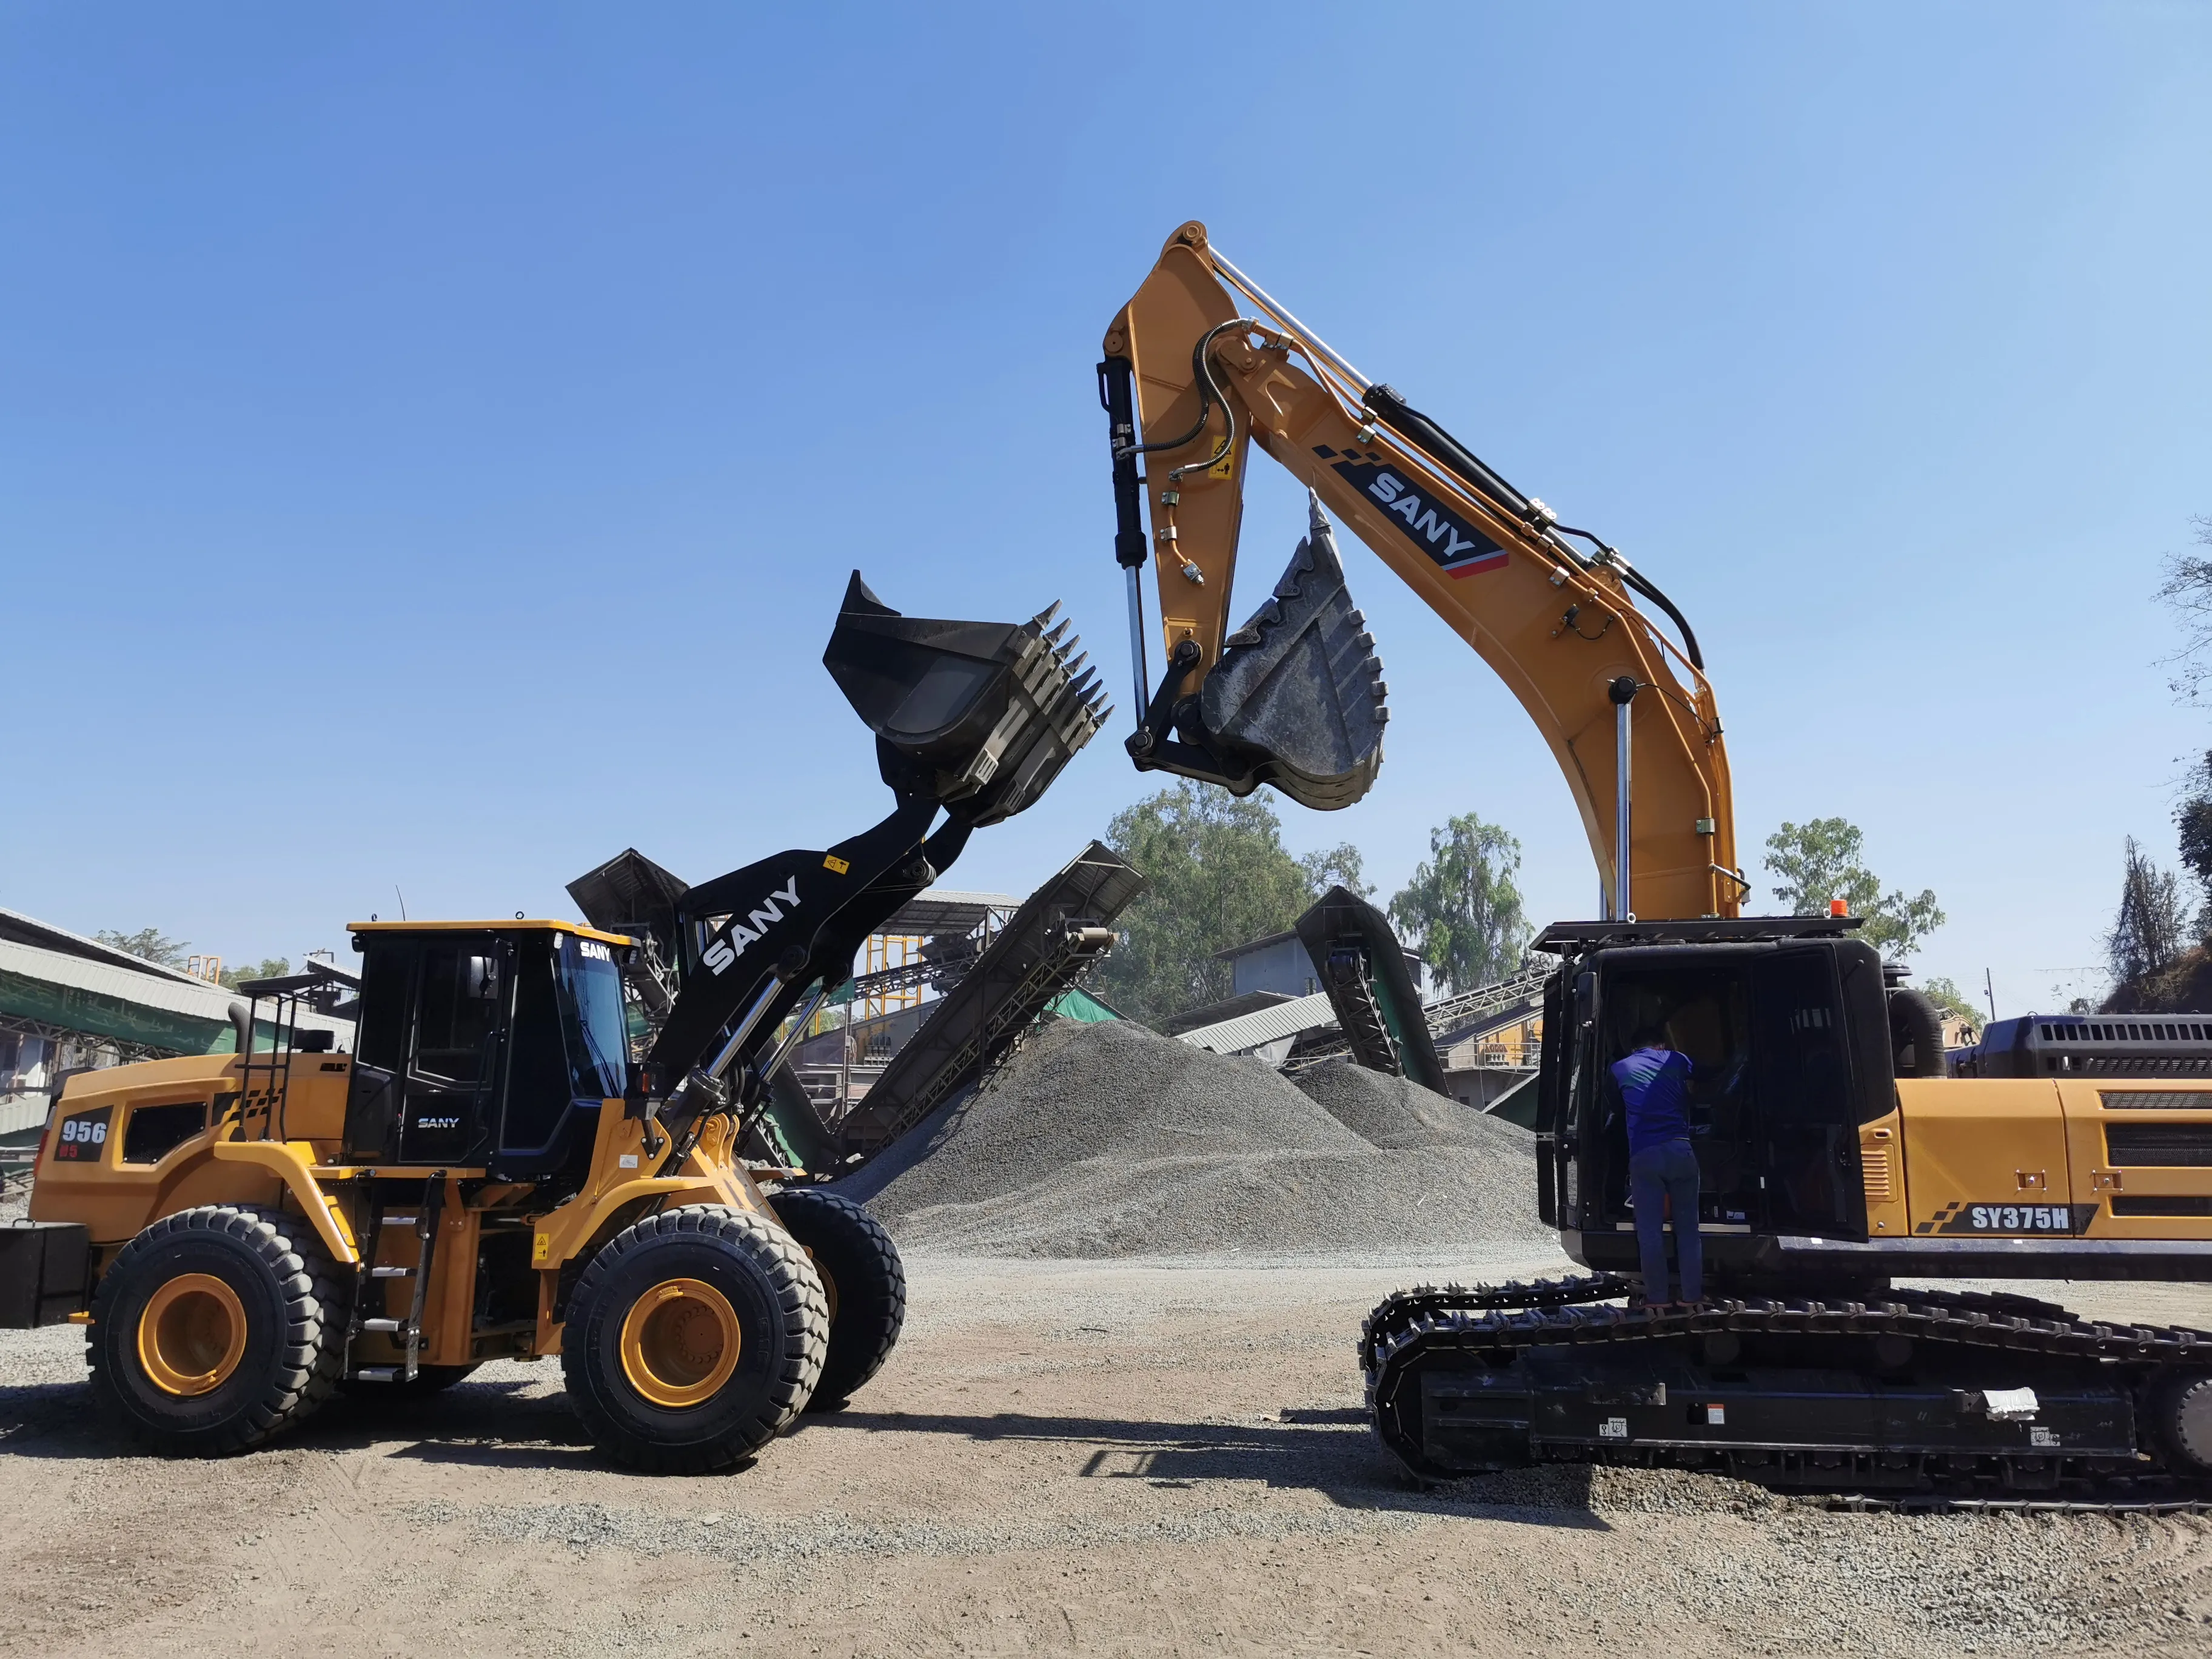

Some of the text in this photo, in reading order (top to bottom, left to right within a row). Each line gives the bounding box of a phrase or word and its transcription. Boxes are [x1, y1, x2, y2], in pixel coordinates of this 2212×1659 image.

[1368, 472, 1475, 557] SANY
[703, 874, 801, 976] SANY
[580, 941, 610, 962] SANY
[62, 1120, 107, 1144] 956
[418, 1118, 460, 1128] SANY
[1972, 1207, 2069, 1228] SY375H
